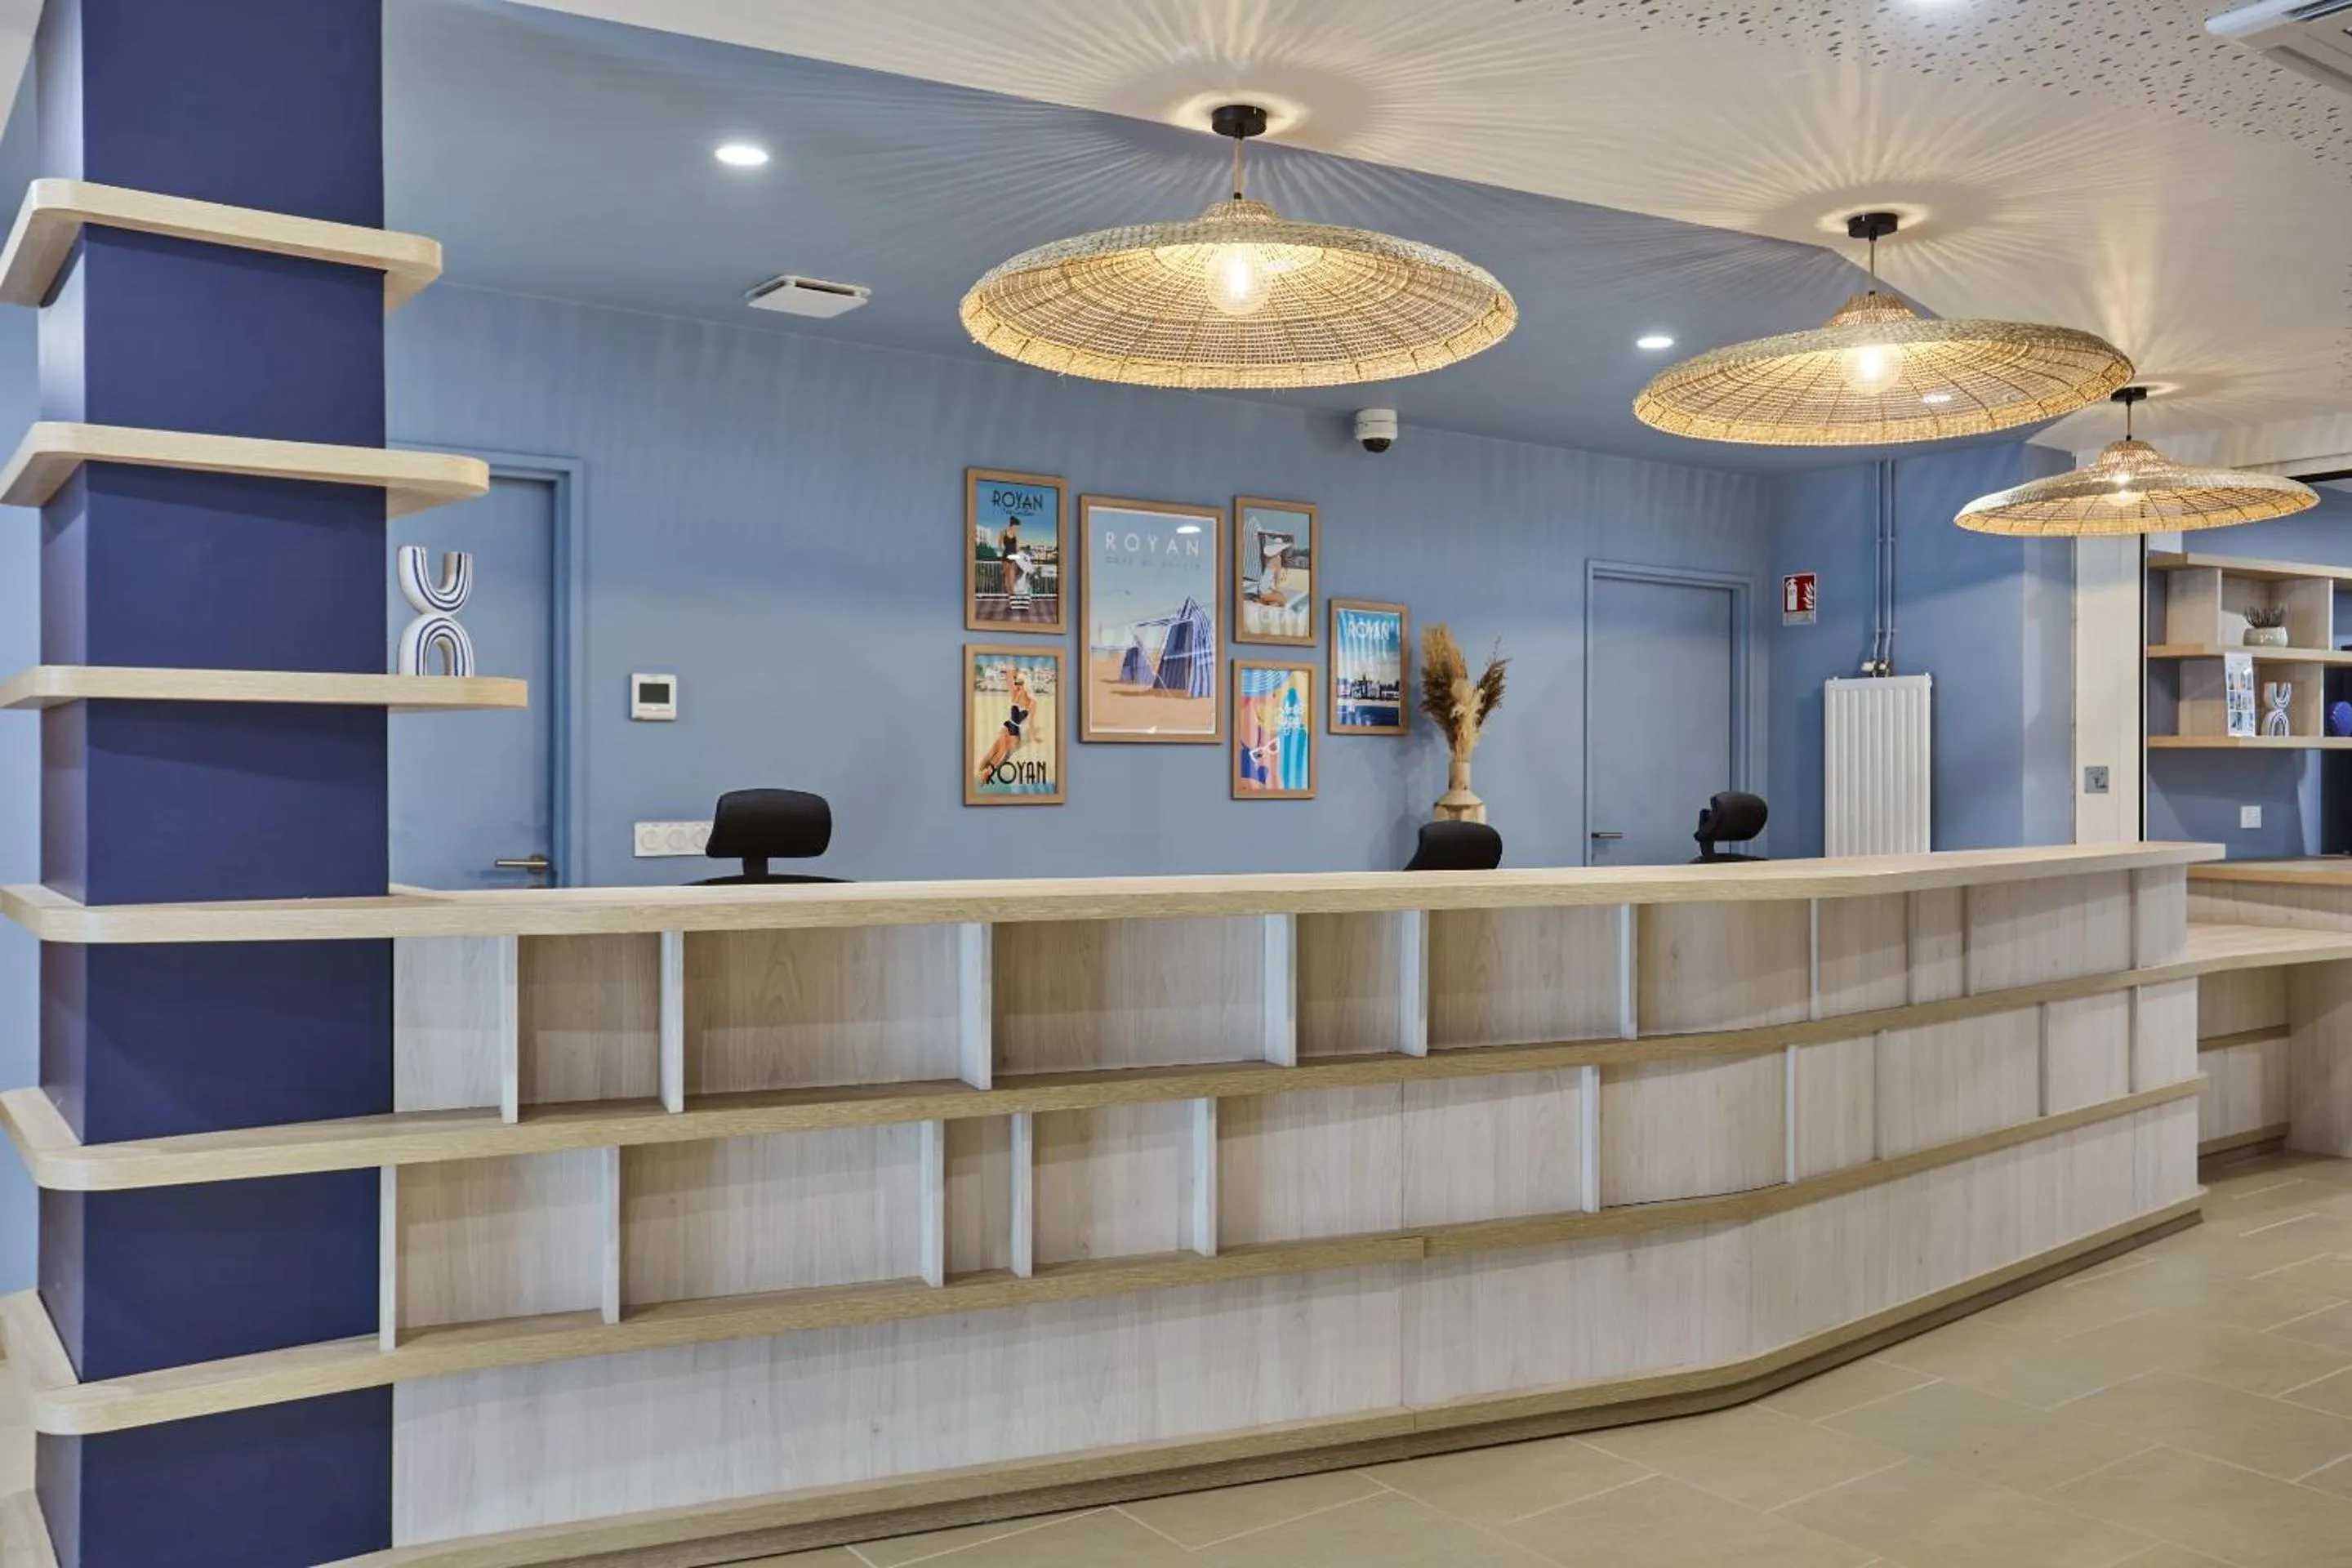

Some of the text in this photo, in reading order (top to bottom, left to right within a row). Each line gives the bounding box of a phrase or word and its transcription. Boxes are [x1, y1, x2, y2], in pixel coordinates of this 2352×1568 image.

[991, 490, 1043, 511] ROYAN
[1105, 531, 1199, 556] ROYAN
[985, 761, 1047, 785] ROYAN
